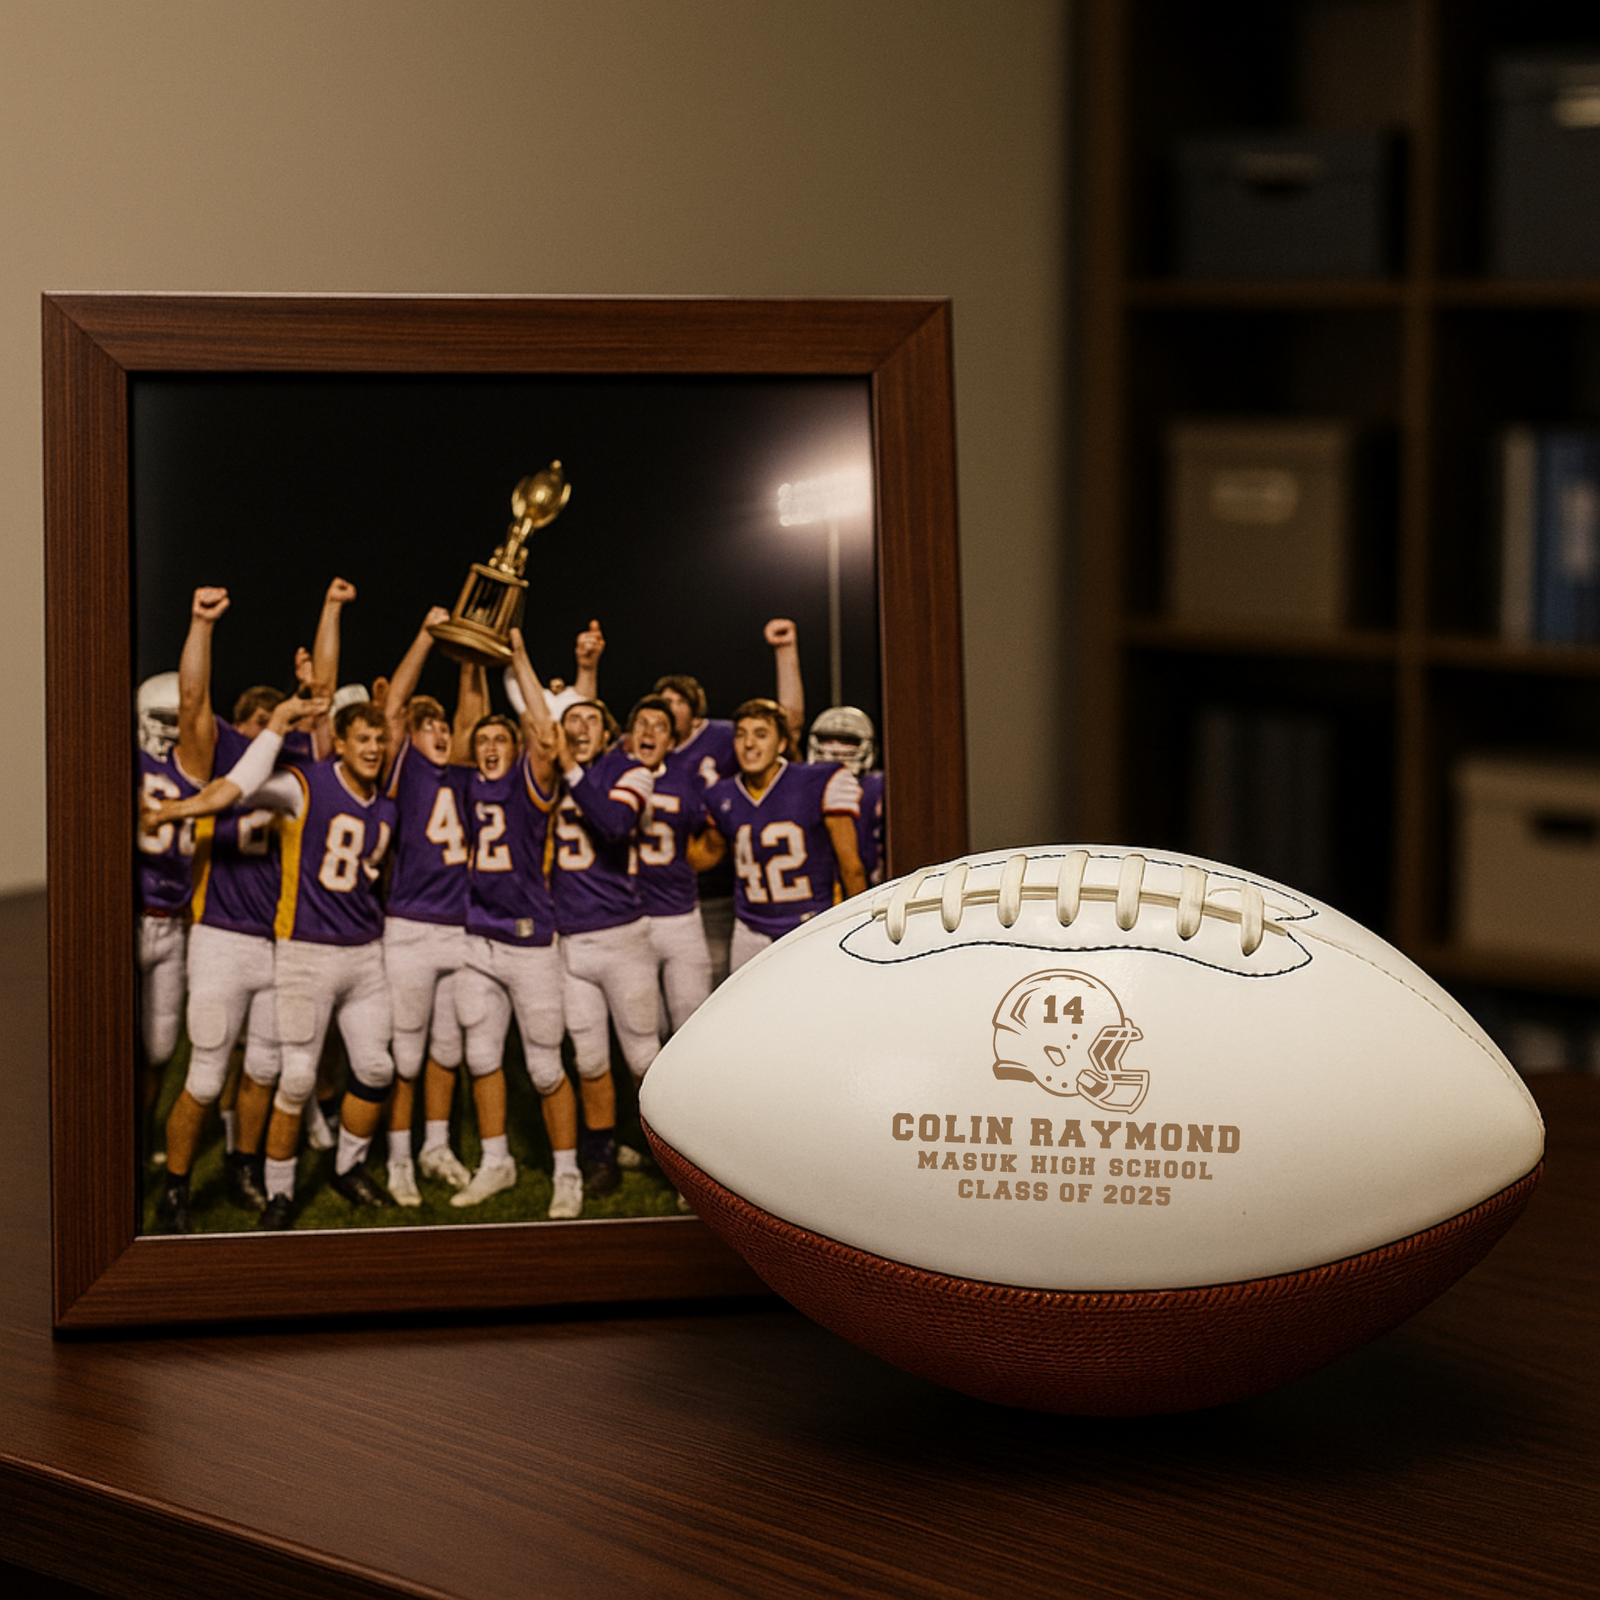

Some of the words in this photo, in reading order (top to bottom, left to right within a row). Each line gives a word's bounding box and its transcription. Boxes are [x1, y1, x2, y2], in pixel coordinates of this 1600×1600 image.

[425, 787, 467, 866] 4
[734, 821, 813, 903] 42
[1043, 995, 1085, 1025] 14
[892, 1112, 1013, 1146] COLIN
[1029, 1117, 1241, 1154] RAYMOND
[917, 1150, 1018, 1173] MASUK
[1030, 1154, 1096, 1176] HIGH
[1108, 1158, 1213, 1181] SCHOOL
[957, 1178, 1049, 1202] CLASS
[1059, 1182, 1093, 1203] OF
[1103, 1184, 1171, 1207] 2025
